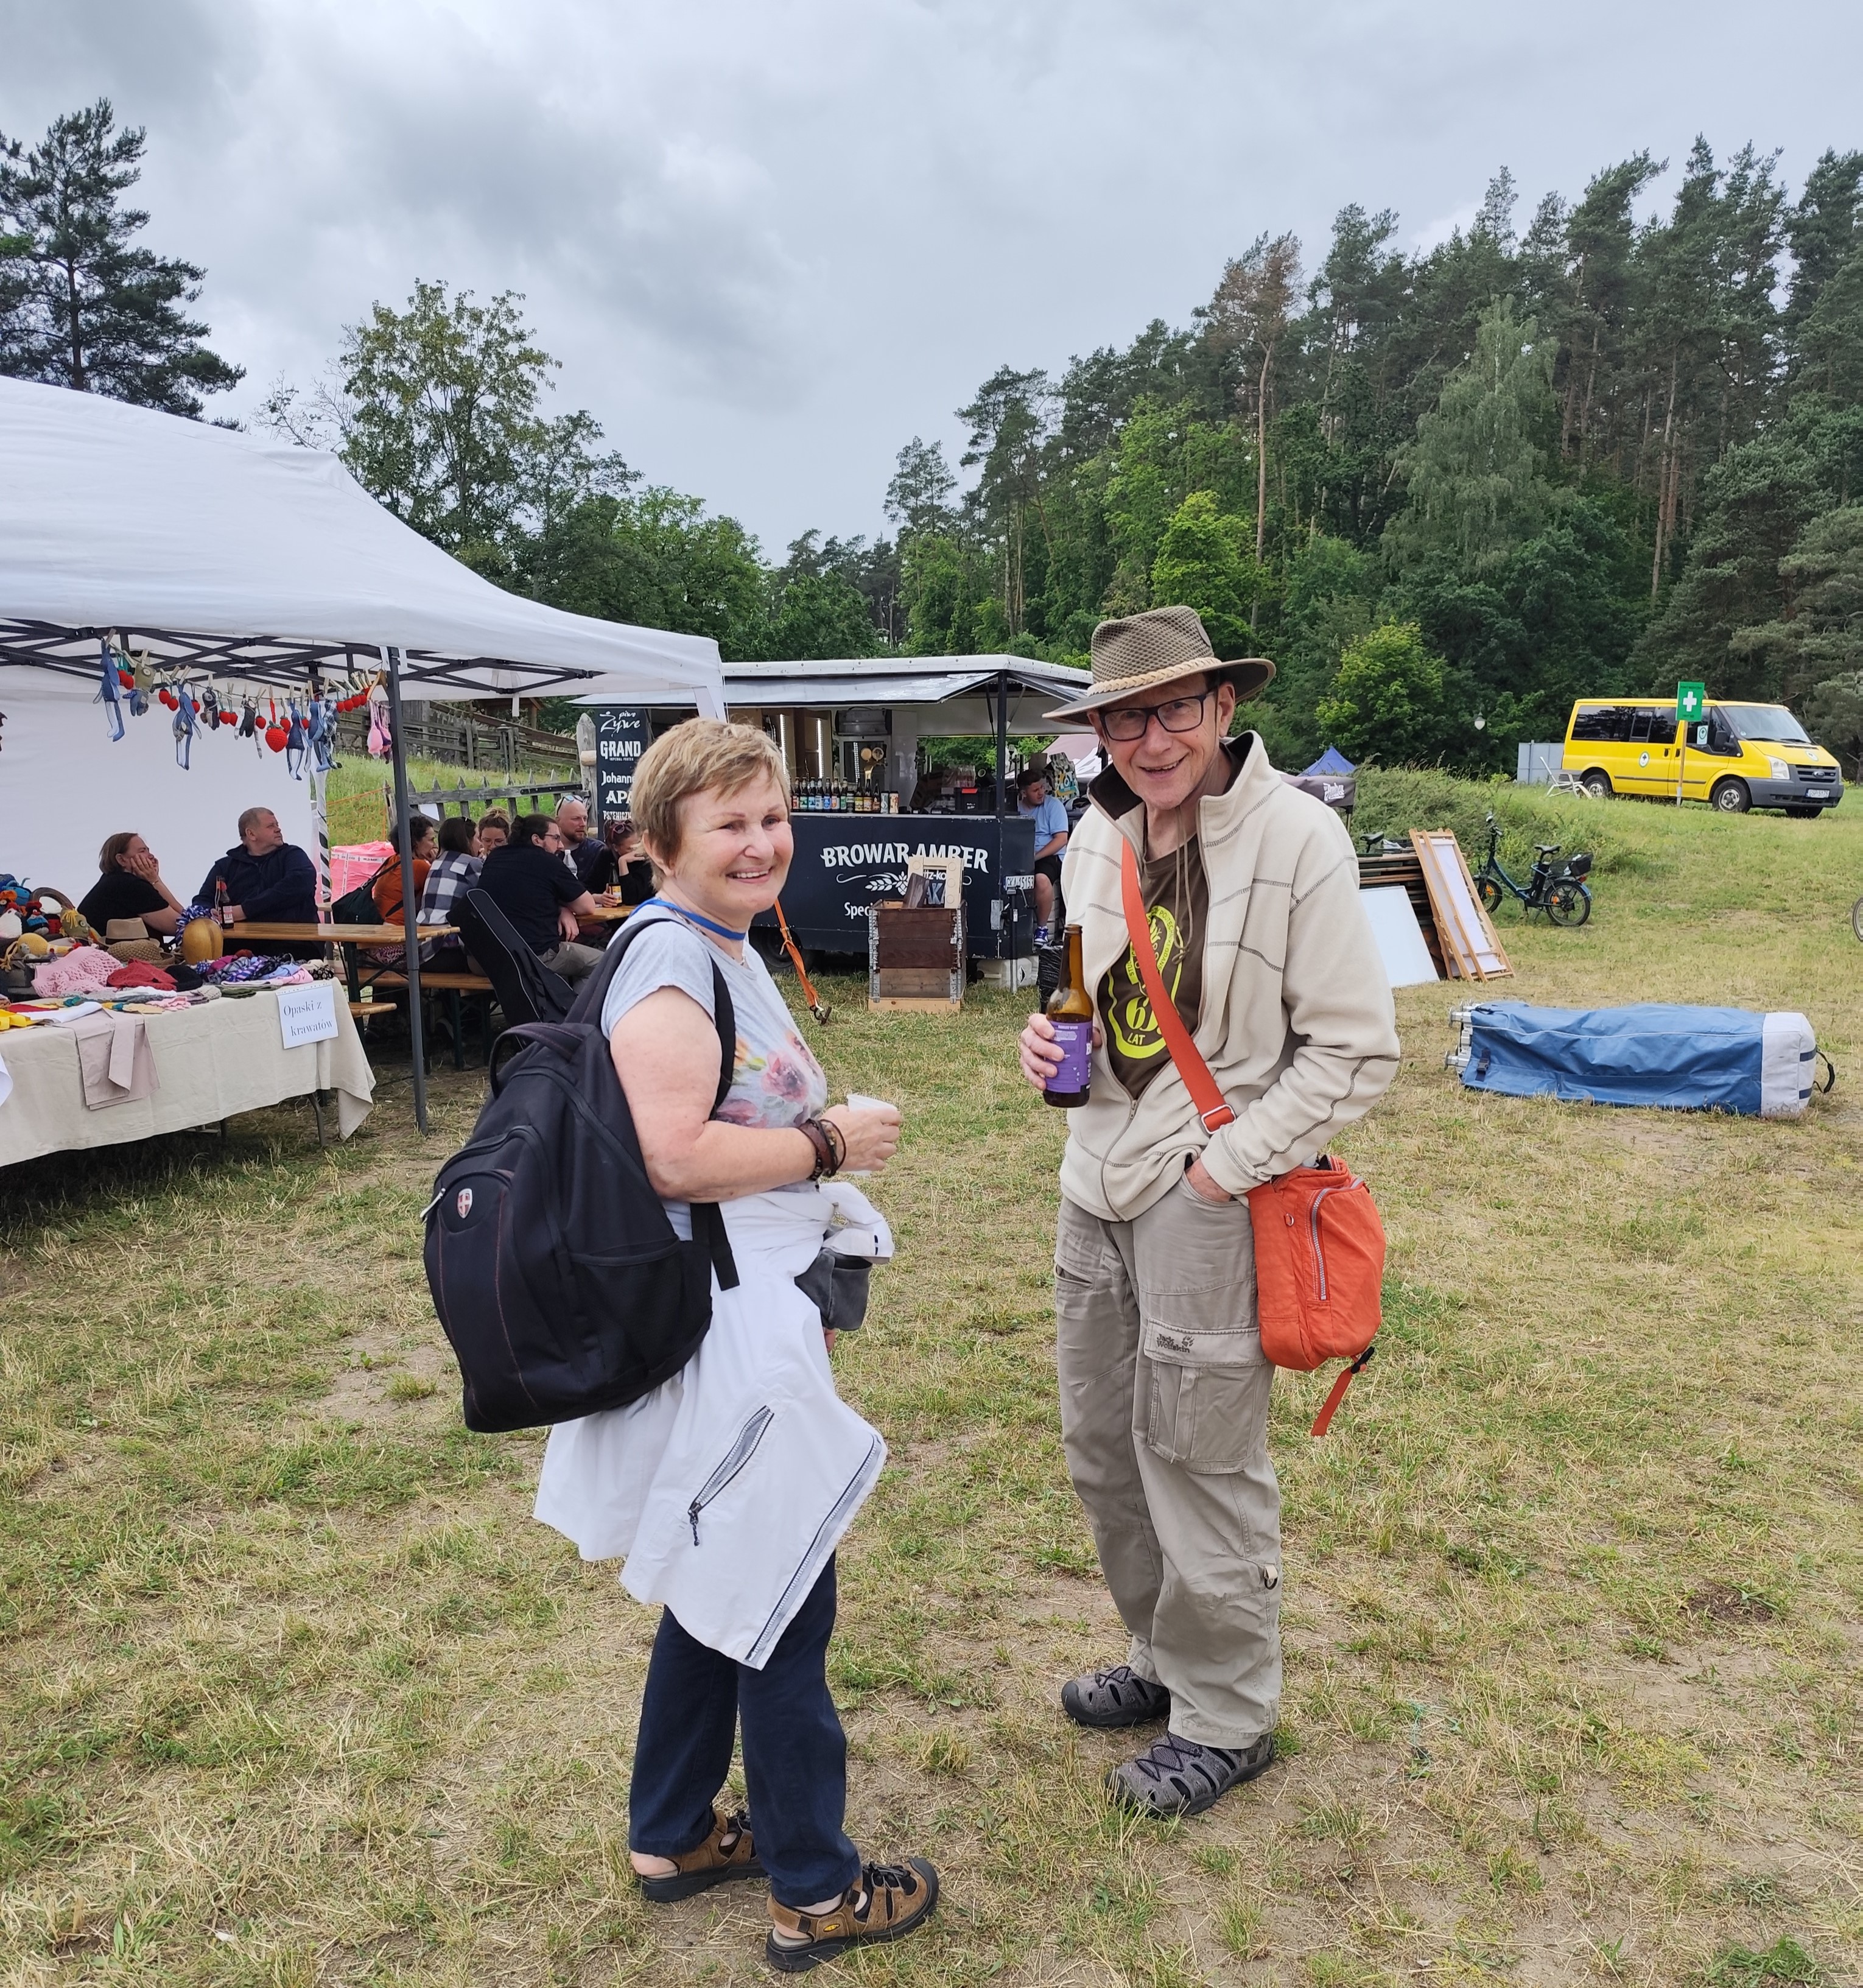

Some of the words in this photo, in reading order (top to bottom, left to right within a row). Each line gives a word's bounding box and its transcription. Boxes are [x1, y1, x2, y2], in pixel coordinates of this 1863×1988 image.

[619, 710, 636, 720] piwo
[600, 740, 641, 760] GRAND
[603, 810, 632, 820] PSZENICZN
[820, 842, 911, 868] BROWAR
[912, 843, 989, 873] AMBER
[844, 902, 873, 919] Spec
[284, 1000, 314, 1018] Opaski
[317, 1002, 322, 1010] z
[291, 1019, 332, 1037] krawatów
[1128, 1032, 1146, 1045] LAT
[1157, 1333, 1174, 1344] Jack
[1156, 1340, 1190, 1354] Wolfskin
